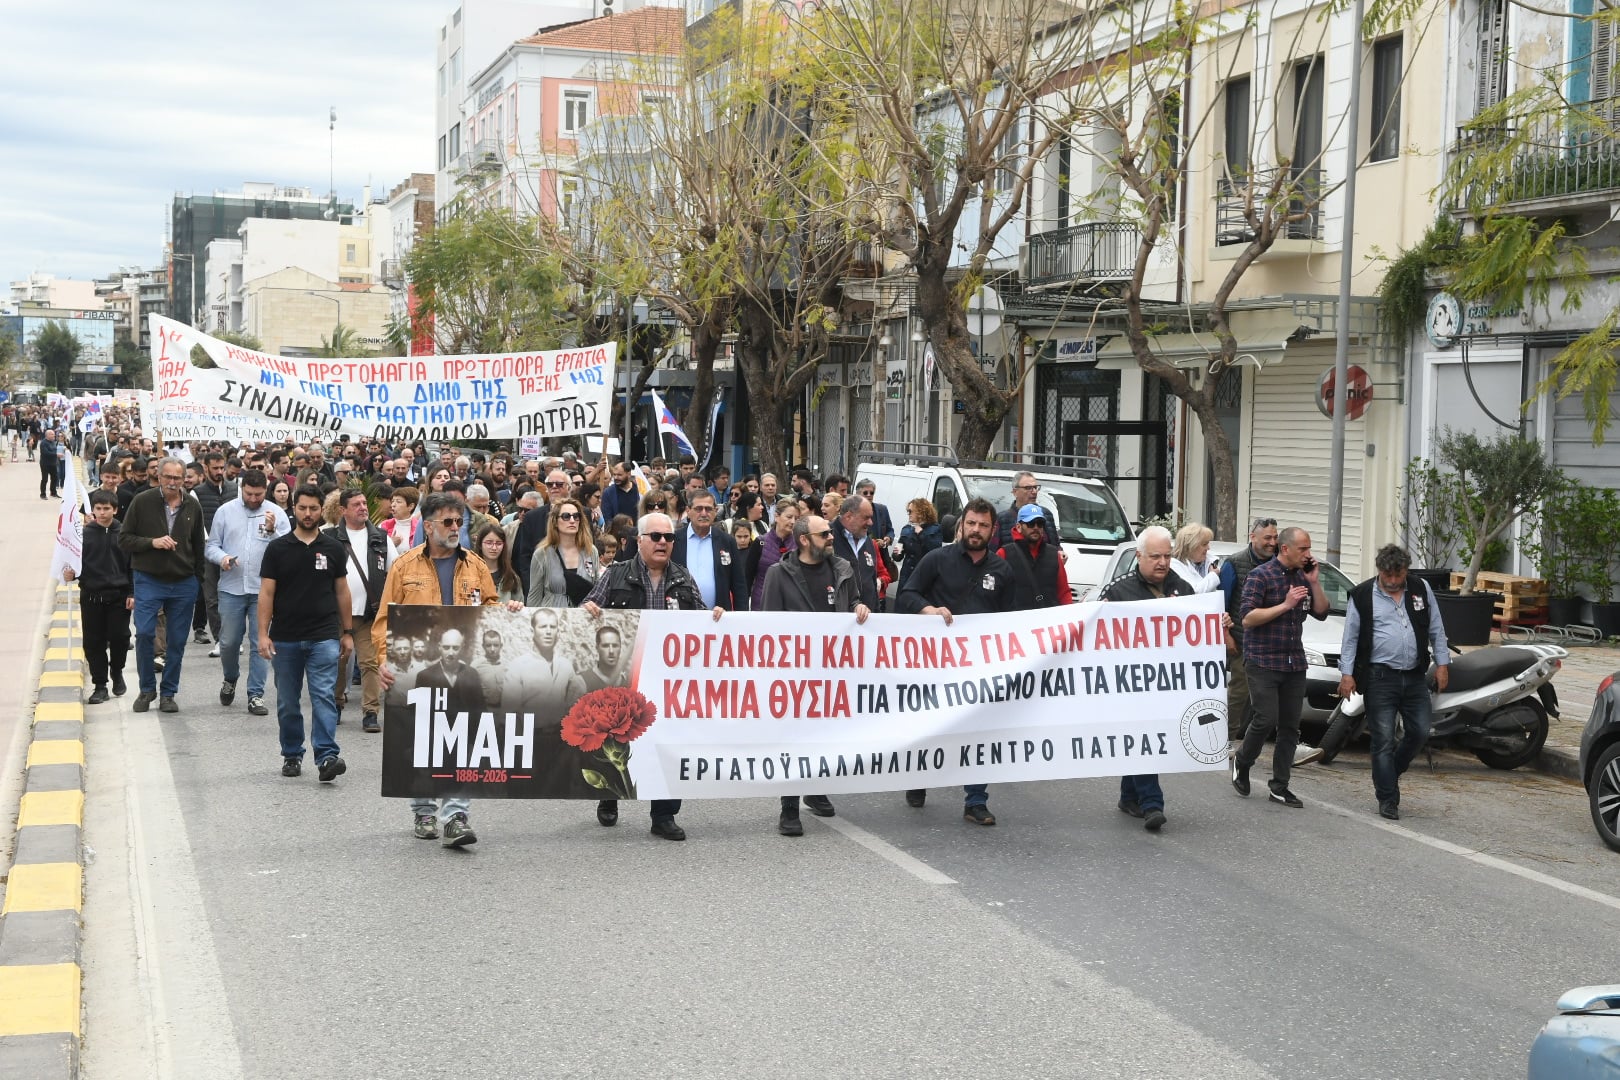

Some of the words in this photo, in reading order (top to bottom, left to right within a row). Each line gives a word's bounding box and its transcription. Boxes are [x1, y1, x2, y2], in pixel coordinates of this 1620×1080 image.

[82, 311, 114, 320] FIBAIR
[260, 369, 285, 389] ΝΑ
[299, 379, 343, 402] ΓΙΝΕΙ
[365, 383, 389, 404] ΤΟ
[413, 380, 461, 404] ΔΙΚΙΟ
[470, 378, 508, 400] ΤΗΣ
[518, 373, 563, 396] ΤΑΞΗΣ
[569, 365, 606, 386] ΜΑΣ
[307, 361, 427, 384] ΠΡΩΤΟΜΑΓΙΑ
[443, 355, 543, 379] ΠΡΩΤΟΠΟΡΑ
[218, 379, 344, 431] ΣΥΝΔΙΚΑΤΟ
[1325, 383, 1369, 400] pnic
[330, 400, 508, 425] ΠΡΑΓΜΑΤΙΚΟΤΗΤΑ
[518, 401, 602, 436] ΠΑΤΡΑΣ
[662, 633, 811, 668] ΟΡΓΑΝΩΣΗ
[822, 634, 866, 669] ΚΑΙ
[874, 636, 973, 669] ΑΓΩΝΑΣ
[979, 632, 1026, 664] ΓΙΑ
[1030, 620, 1084, 655] ΤΗΝ
[663, 679, 760, 719] ΚΑΜΙΑ
[768, 679, 852, 718] ΘΥΣΙΑ
[857, 683, 890, 714] ΓΙΑ
[896, 683, 940, 712] ΤΟΝ
[943, 670, 1036, 707] ΠΟΛΕΜΟ
[1040, 667, 1076, 698] ΚΑΙ
[1081, 665, 1110, 695] ΤΑ
[1115, 662, 1187, 693] ΚΕΡΔΗ
[432, 711, 535, 769] ΜΑΗ
[679, 747, 945, 781] ΕΡΓΑΤΟΫΠΑΛΛΗΛΙΚΟ
[959, 739, 1054, 767] ΚΕΝΤΡΟ
[1071, 733, 1168, 760] ΠΑΤΡΑΣ
[455, 769, 508, 783] 1886-2026
